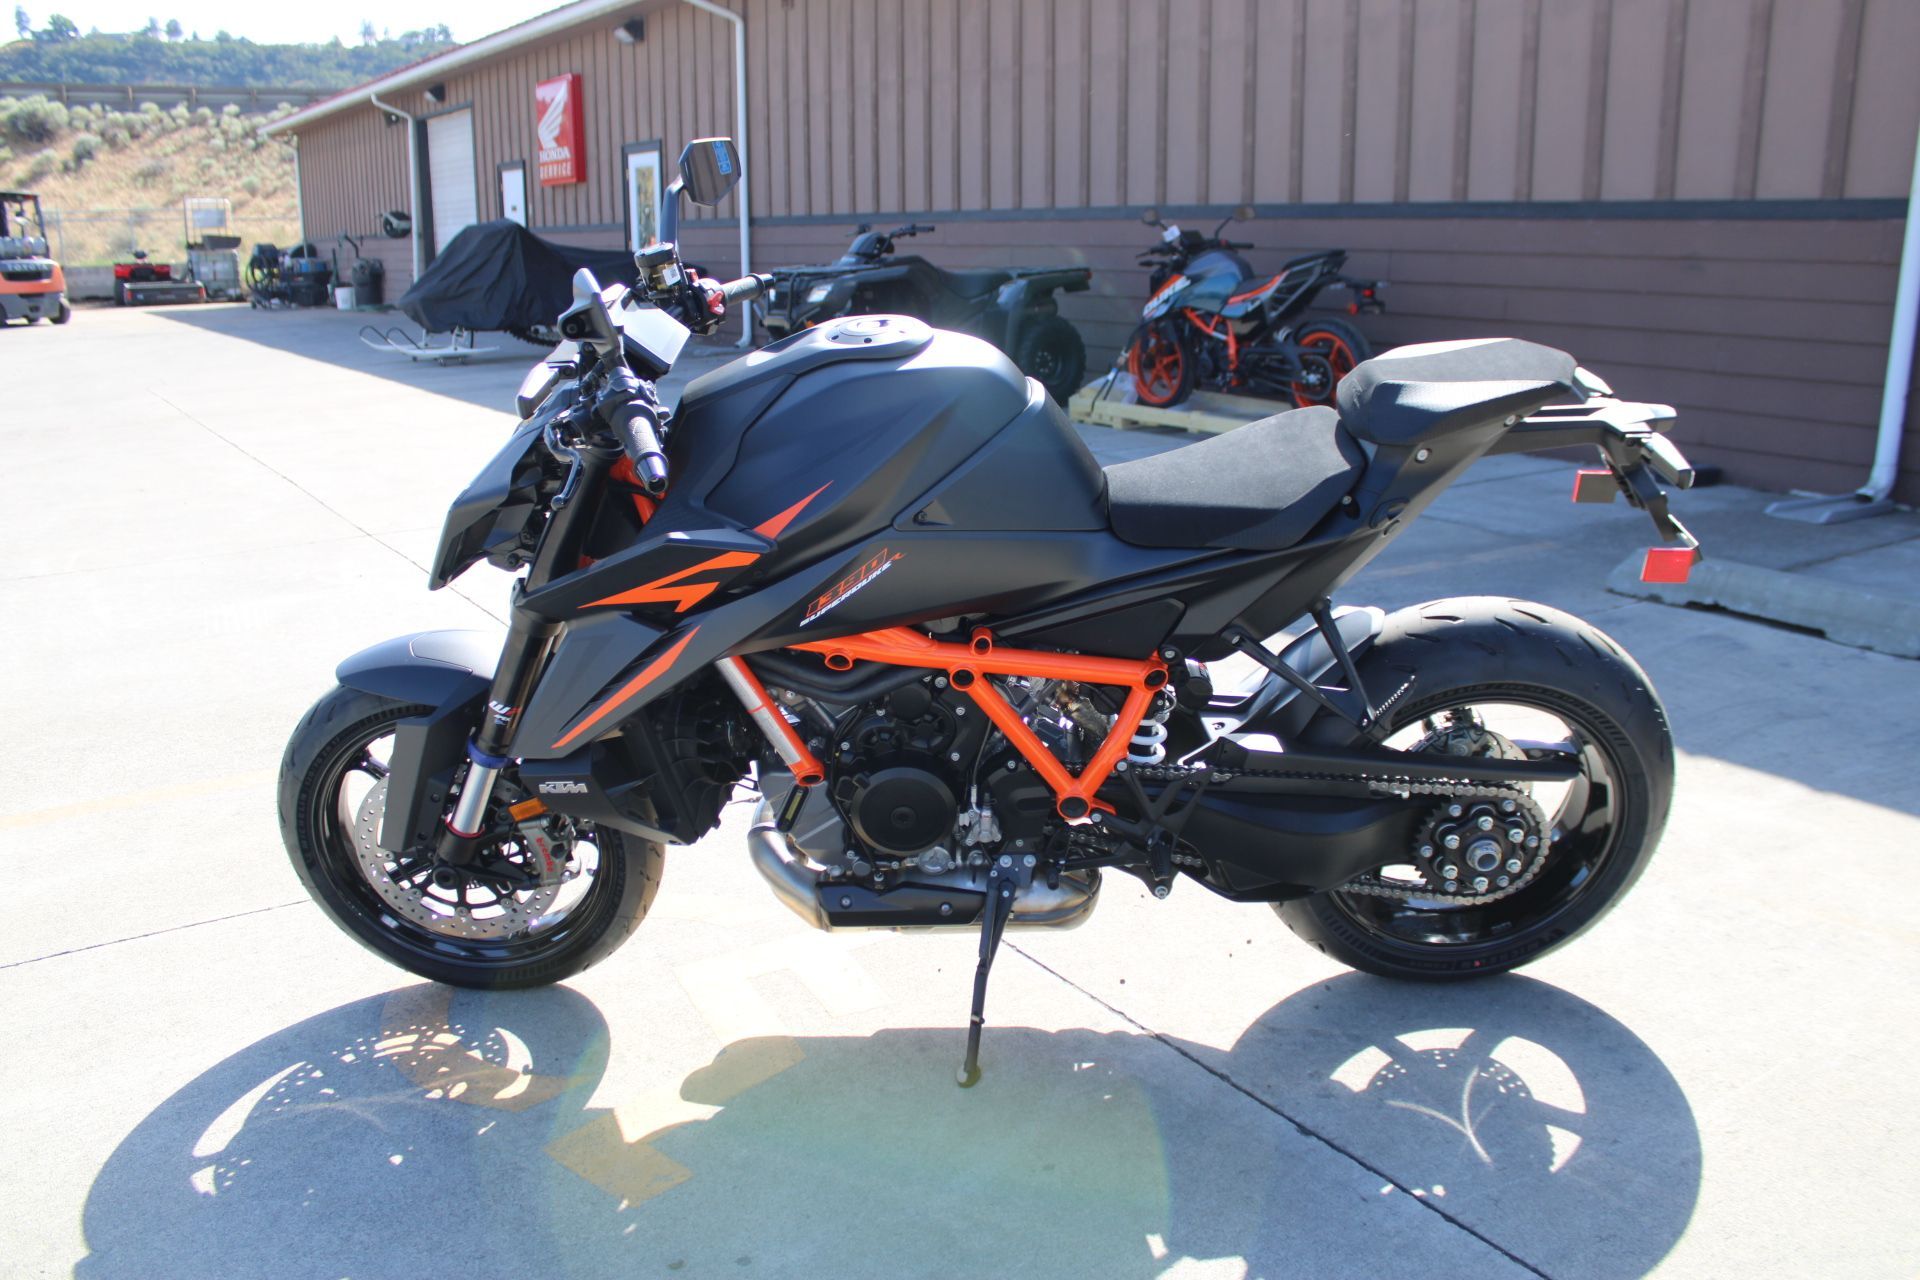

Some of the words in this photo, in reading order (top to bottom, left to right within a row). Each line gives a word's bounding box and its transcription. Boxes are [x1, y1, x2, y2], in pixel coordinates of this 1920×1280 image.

[539, 147, 571, 163] HONDA
[539, 160, 572, 180] SERVICE
[538, 781, 589, 794] KTM
